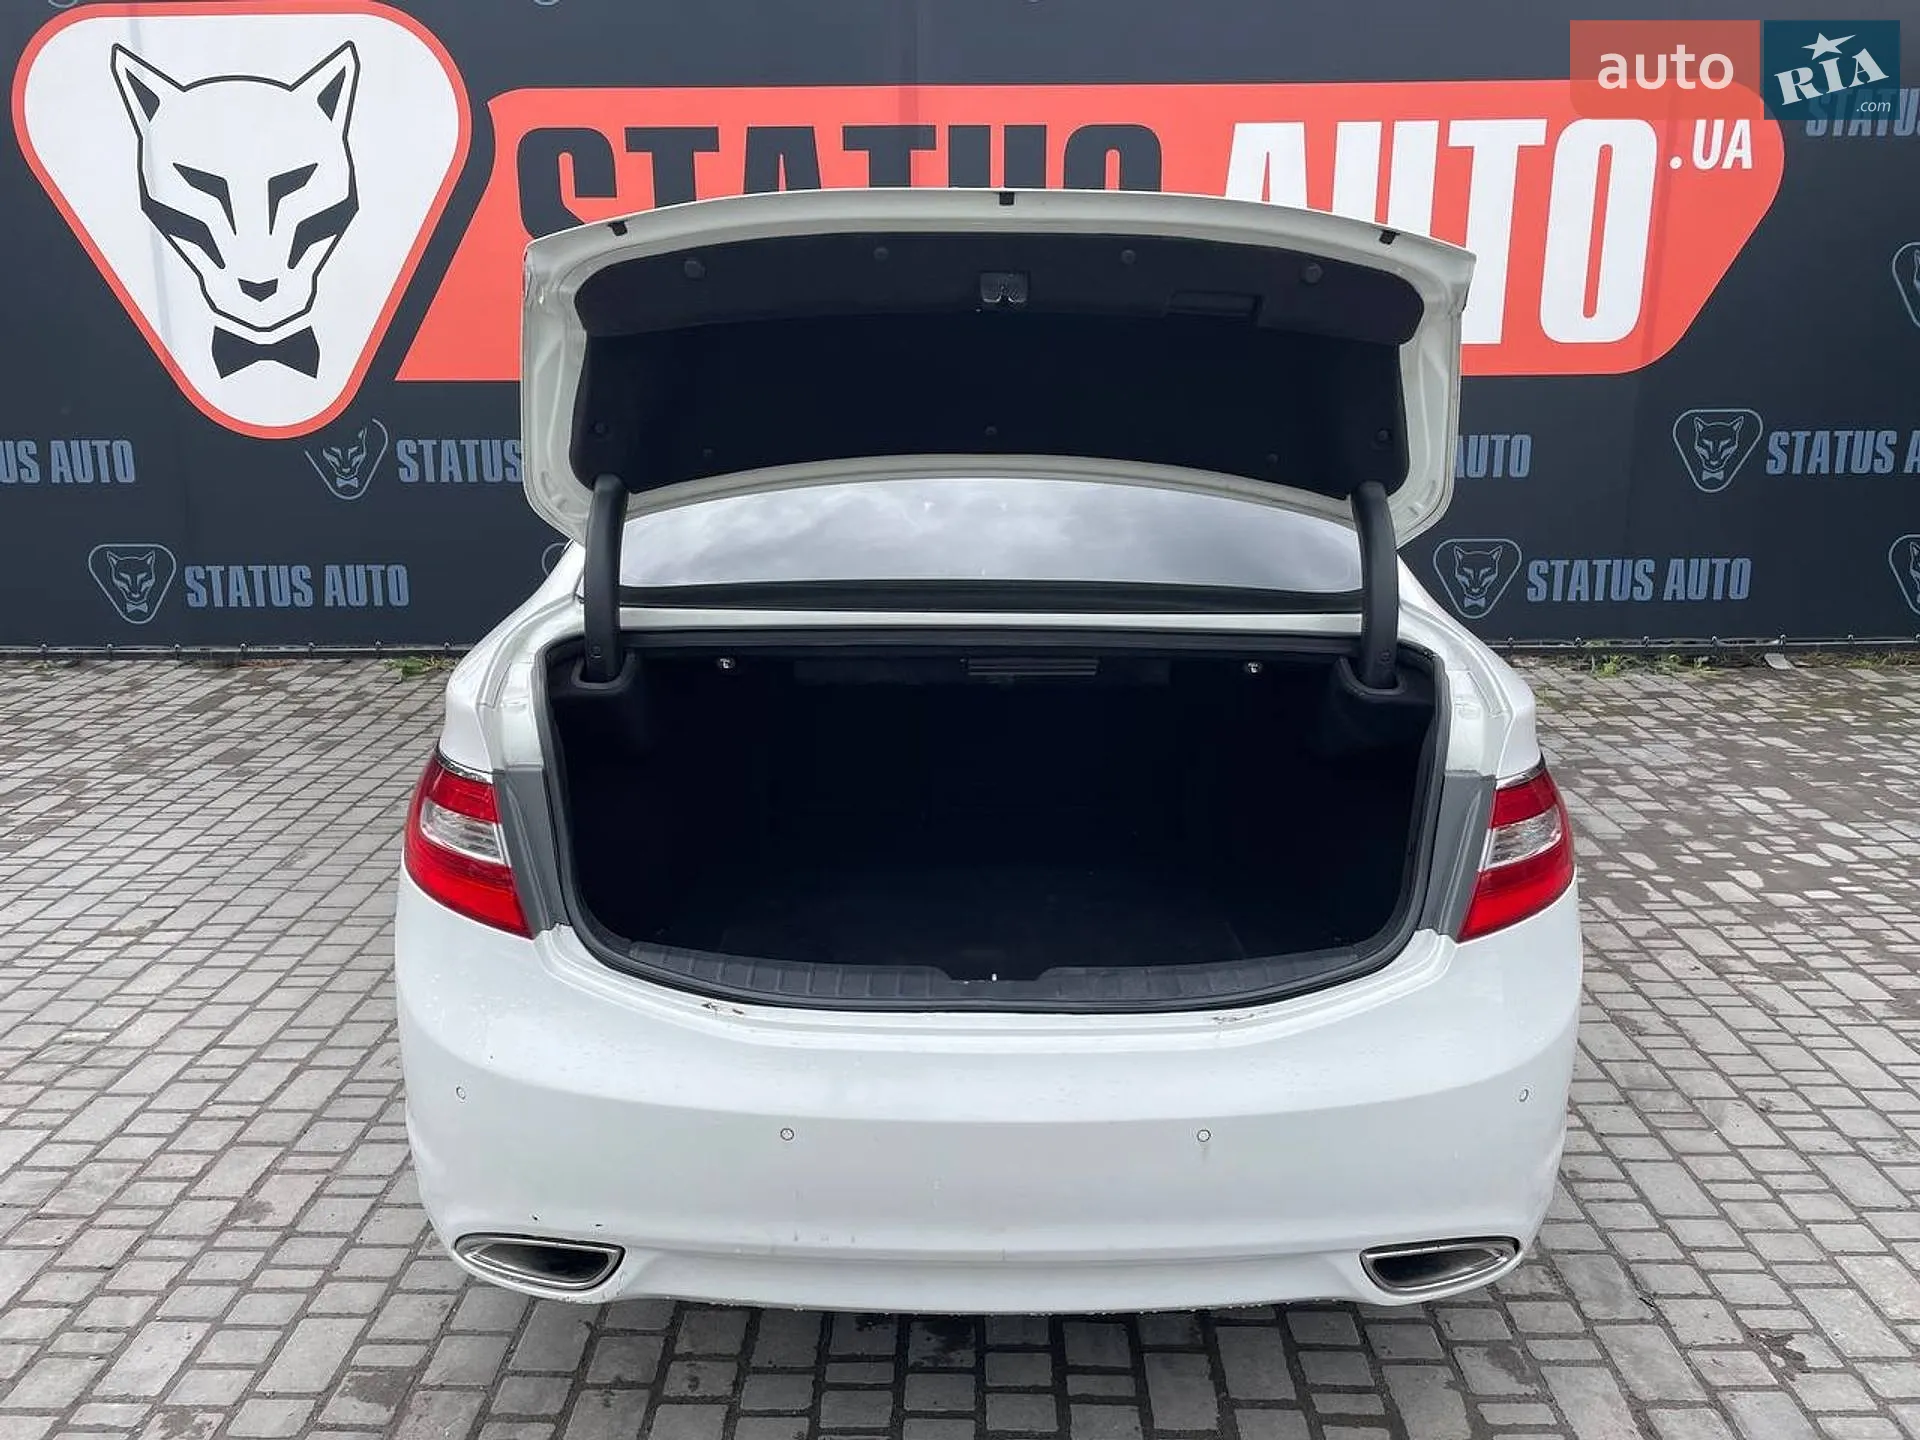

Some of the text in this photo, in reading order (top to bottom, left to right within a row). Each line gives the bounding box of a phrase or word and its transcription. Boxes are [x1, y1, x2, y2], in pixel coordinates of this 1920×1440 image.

[1806, 88, 1920, 136] STATU
[1669, 118, 1753, 169] .UA
[50, 440, 135, 483] AUTO
[396, 439, 522, 483] STATUS
[1766, 430, 1898, 475] STATUS
[185, 564, 409, 608] STATUS AUTO
[1527, 558, 1752, 602] STATUS AUTO
